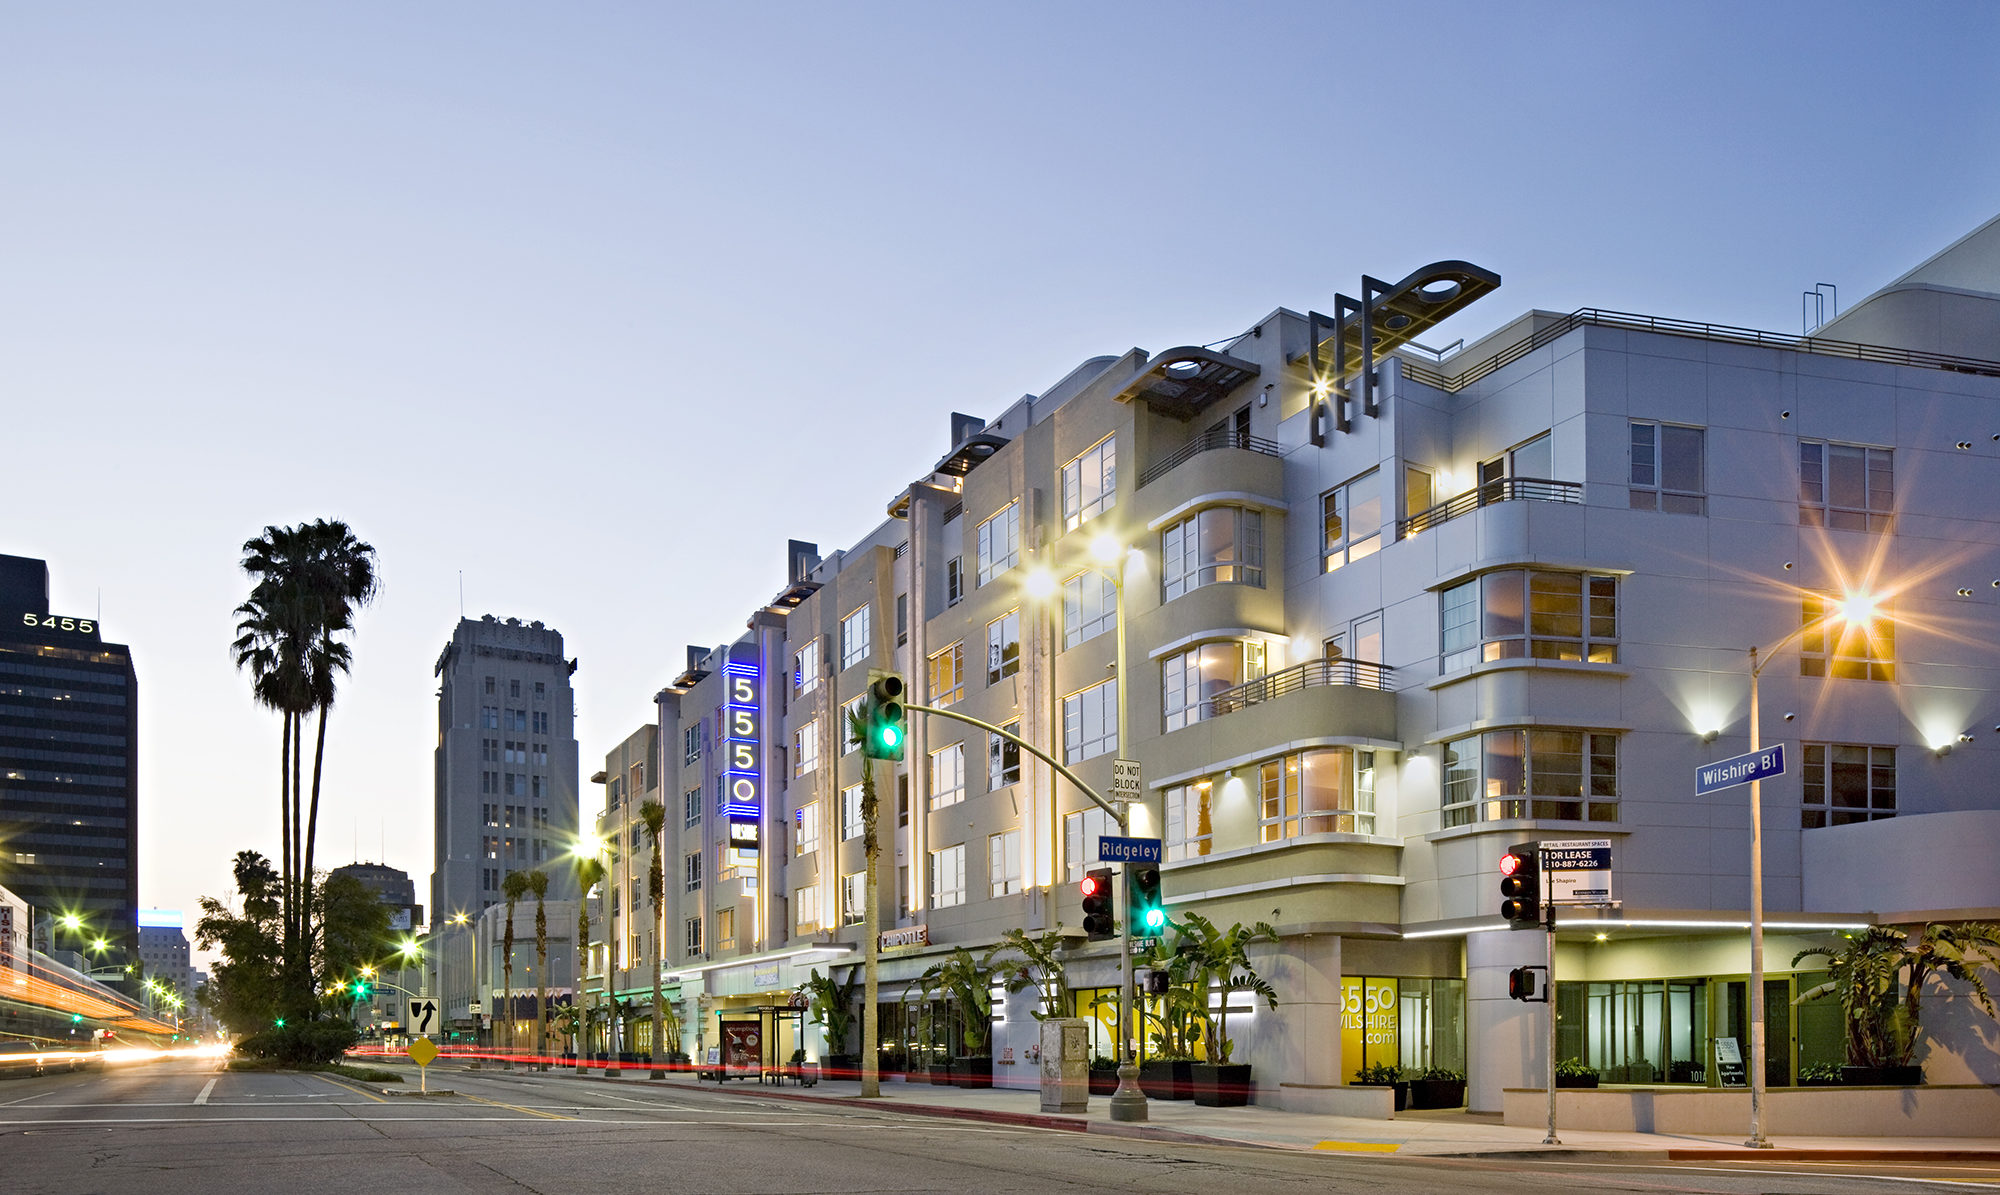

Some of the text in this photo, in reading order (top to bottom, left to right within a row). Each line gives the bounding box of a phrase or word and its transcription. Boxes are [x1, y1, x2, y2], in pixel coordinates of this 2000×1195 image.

[23, 613, 94, 634] 5455
[733, 677, 756, 803] 5550
[1114, 765, 1140, 777] DO NOT
[1704, 753, 1776, 785] Wilshire Bl
[1115, 778, 1140, 790] BLOCK
[1115, 791, 1140, 799] INTERSECTION
[1101, 842, 1159, 860] Ridgeley
[1564, 851, 1592, 859] LEASE
[1, 907, 11, 926] HIS
[881, 930, 926, 948] CHIPOTLE
[1360, 1032, 1395, 1044] .com
